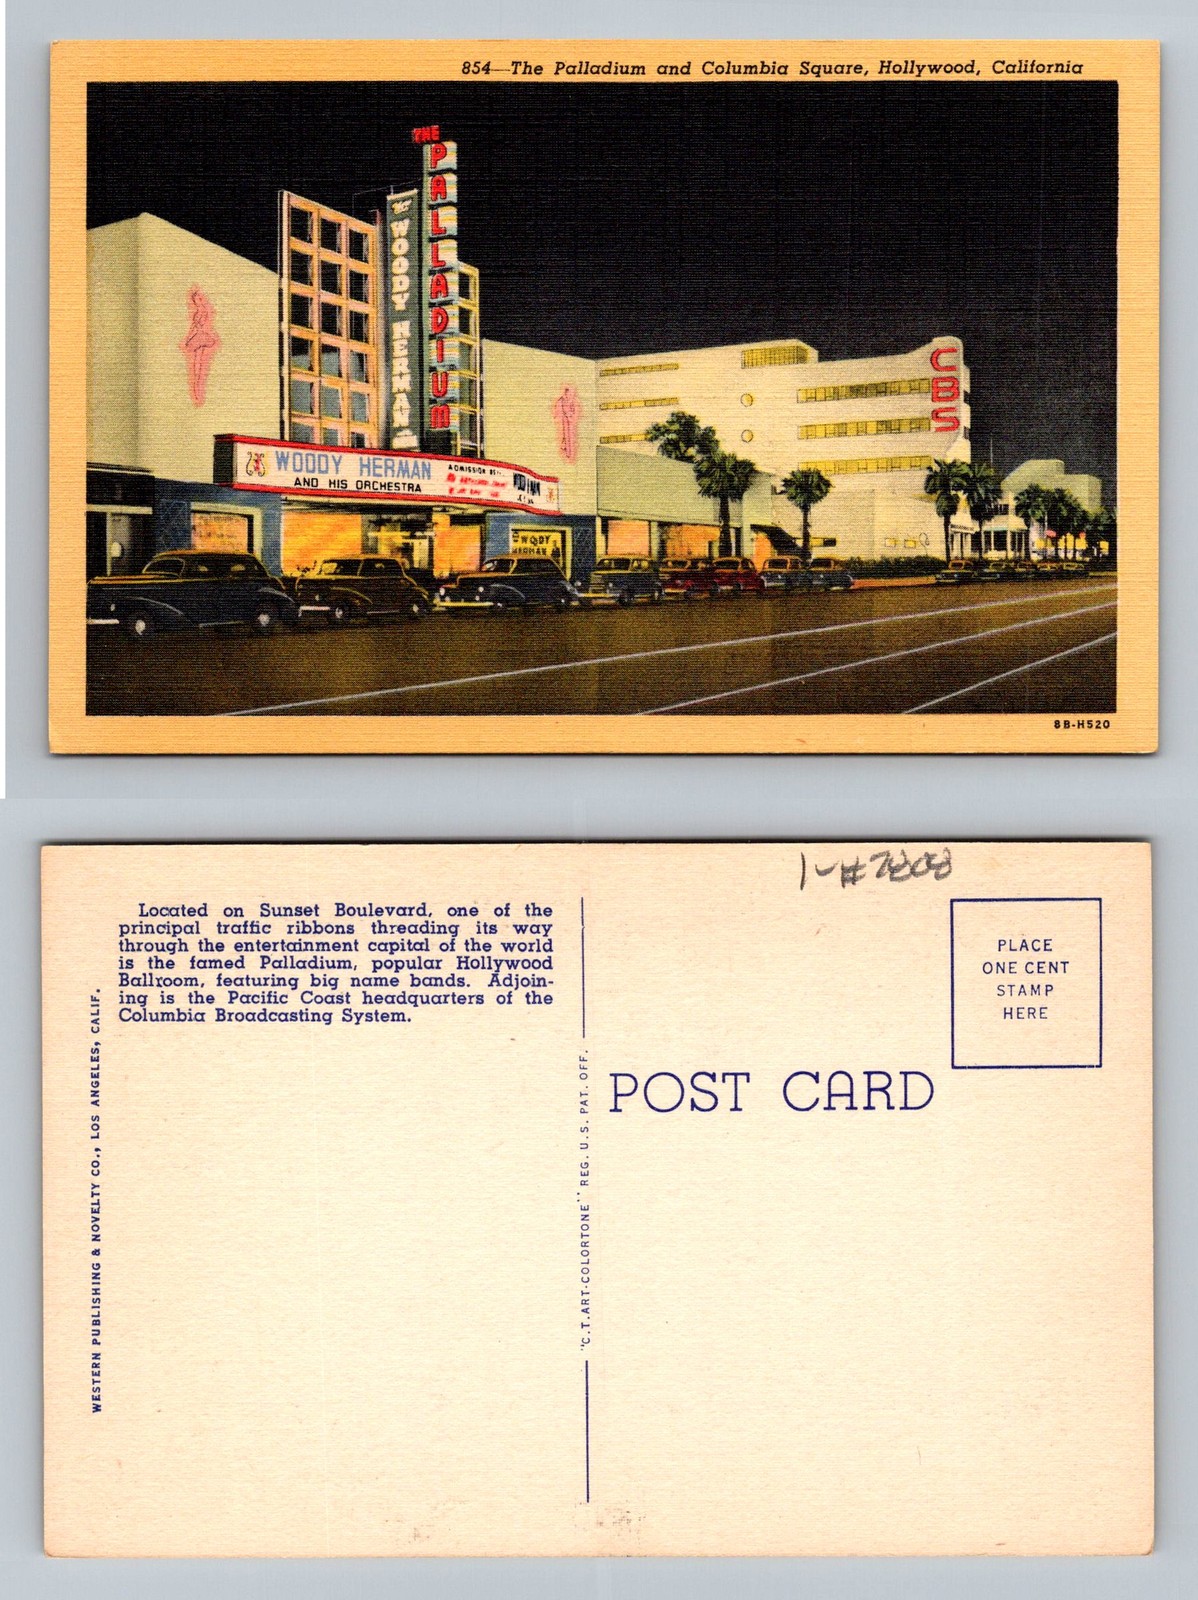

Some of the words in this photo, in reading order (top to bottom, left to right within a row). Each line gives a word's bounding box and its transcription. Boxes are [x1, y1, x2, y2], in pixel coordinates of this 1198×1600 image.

[554, 61, 645, 75] Palladium
[657, 61, 691, 75] and
[702, 61, 788, 75] Columbia
[799, 61, 868, 78] Square,
[878, 60, 980, 77] Hollywood,
[992, 60, 1083, 74] California
[412, 125, 440, 143] THE
[430, 143, 450, 429] PALLADIUM
[929, 347, 960, 432] CBS
[275, 450, 343, 475] WOODY
[359, 456, 432, 480] HERMAN
[294, 477, 319, 489] AND
[329, 479, 348, 490] HIS
[355, 479, 422, 493] ORCHESTRA
[1054, 720, 1110, 729] 8B-H520
[139, 903, 208, 917] Located
[223, 907, 244, 917] on
[260, 903, 319, 917] Sunset
[335, 902, 432, 917] Boulevard,
[447, 907, 479, 917] one
[494, 903, 510, 917] of
[525, 903, 552, 917] the
[119, 921, 200, 937] principal
[217, 920, 271, 934] traffic
[287, 920, 354, 934] ribbons
[371, 920, 459, 937] threading
[476, 921, 497, 934] its
[513, 924, 553, 937] way
[119, 938, 189, 955] through
[198, 938, 225, 952] the
[234, 938, 359, 952] entertainment
[368, 938, 430, 955] capital
[439, 938, 455, 952] of
[464, 938, 492, 952] the
[501, 938, 553, 952] world
[998, 939, 1052, 952] PLACE
[119, 956, 134, 969] is
[148, 956, 175, 969] the
[190, 955, 245, 969] famed
[260, 955, 357, 971] Palladium,
[372, 956, 442, 973] popular
[456, 956, 553, 972] Hollywood
[983, 962, 1017, 974] ONE
[1025, 961, 1069, 974] CENT
[118, 973, 204, 988] Ballroom,
[216, 973, 299, 990] featuring
[310, 974, 339, 990] big
[350, 977, 399, 987] name
[410, 973, 470, 987] bands.
[488, 974, 553, 991] Adjoin-
[997, 984, 1053, 996] STAMP
[119, 991, 148, 1007] ing
[160, 991, 174, 1004] is
[188, 991, 215, 1004] the
[228, 991, 288, 1004] Pacific
[301, 991, 350, 1004] Coast
[362, 991, 484, 1007] headquarters
[496, 991, 512, 1004] of
[525, 990, 553, 1005] the
[91, 989, 100, 1033] CALIF.
[119, 1008, 206, 1022] Columbia
[215, 1008, 333, 1025] Broadcasting
[342, 1008, 411, 1025] System.
[1004, 1007, 1047, 1019] HERE
[91, 1042, 101, 1107] ANGELES,
[579, 1050, 588, 1080] OFF.
[580, 1086, 588, 1113] PAT.
[610, 1072, 750, 1112] POST
[783, 1071, 934, 1111] CARD
[91, 1115, 100, 1139] LOS
[580, 1121, 589, 1149] U.S.
[91, 1148, 101, 1176] CO.,
[580, 1156, 589, 1186] REG.
[91, 1183, 100, 1242] NOVELTY
[91, 1263, 101, 1345] PUBLISHING
[92, 1353, 101, 1413] WESTERN
